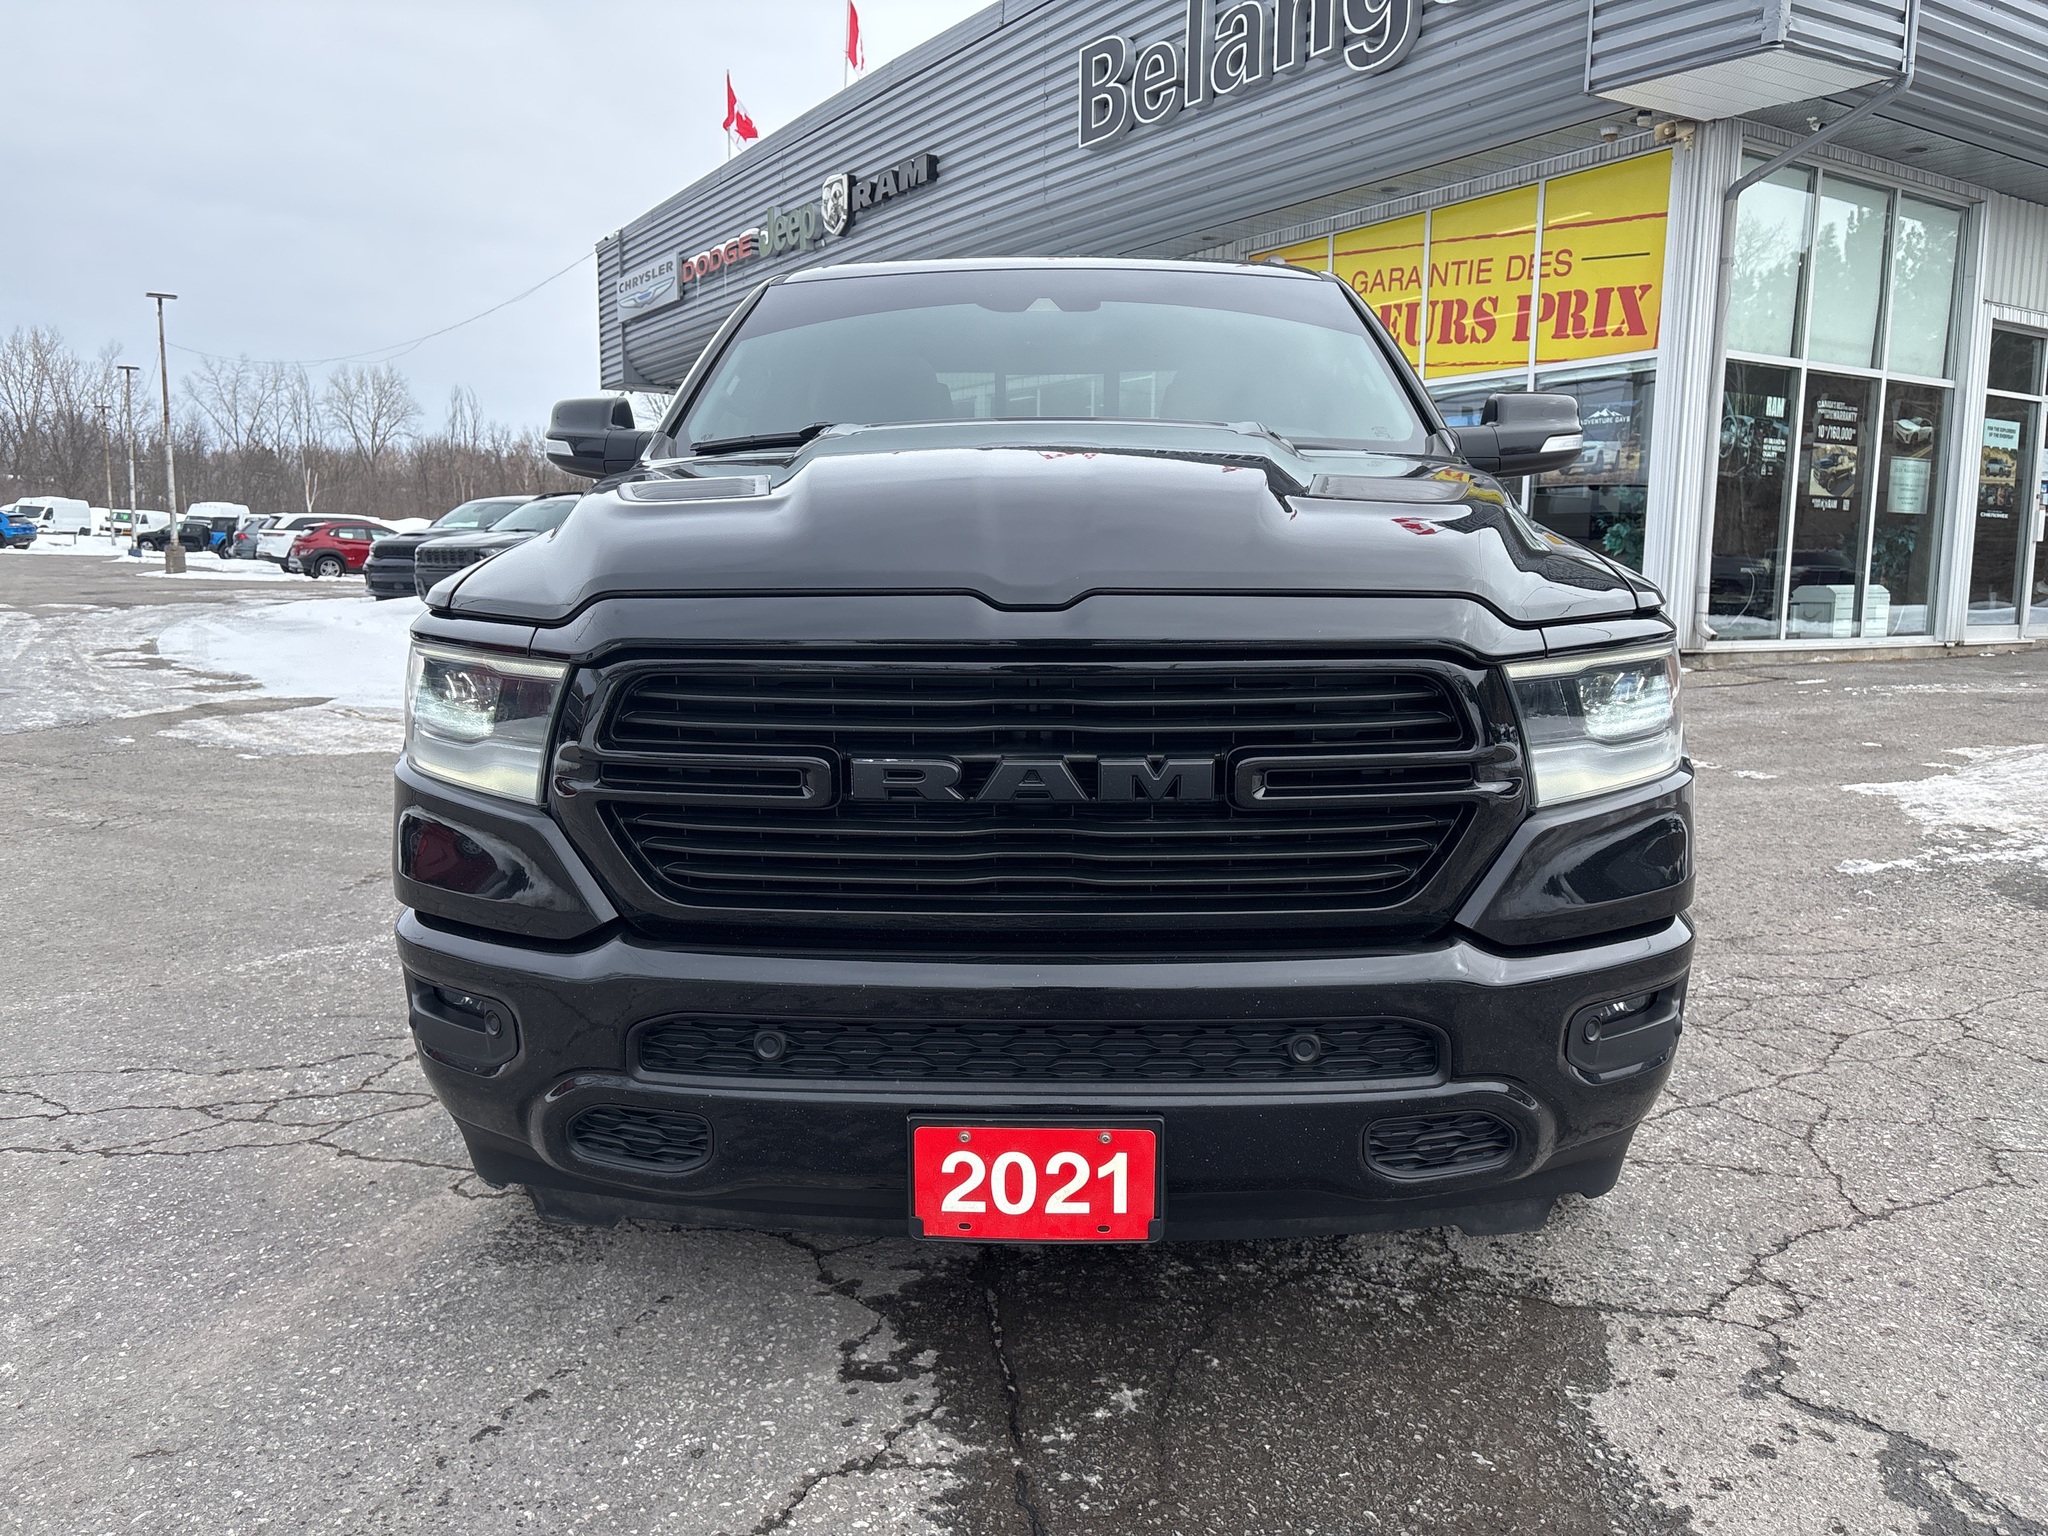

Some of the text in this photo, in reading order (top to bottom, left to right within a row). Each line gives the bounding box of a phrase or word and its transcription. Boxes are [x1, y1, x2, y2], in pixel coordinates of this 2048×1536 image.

[1079, 0, 1459, 148] Belang
[852, 153, 930, 213] RAM
[759, 202, 817, 257] Jeep
[619, 261, 674, 293] CHRYSLER
[682, 233, 753, 282] DODGE
[1351, 248, 1573, 294] GARANTIE DES
[1512, 284, 1653, 341] PRIX
[1766, 396, 1786, 417] RAM
[851, 757, 1215, 801] RAM
[941, 1150, 1128, 1215] 2021
